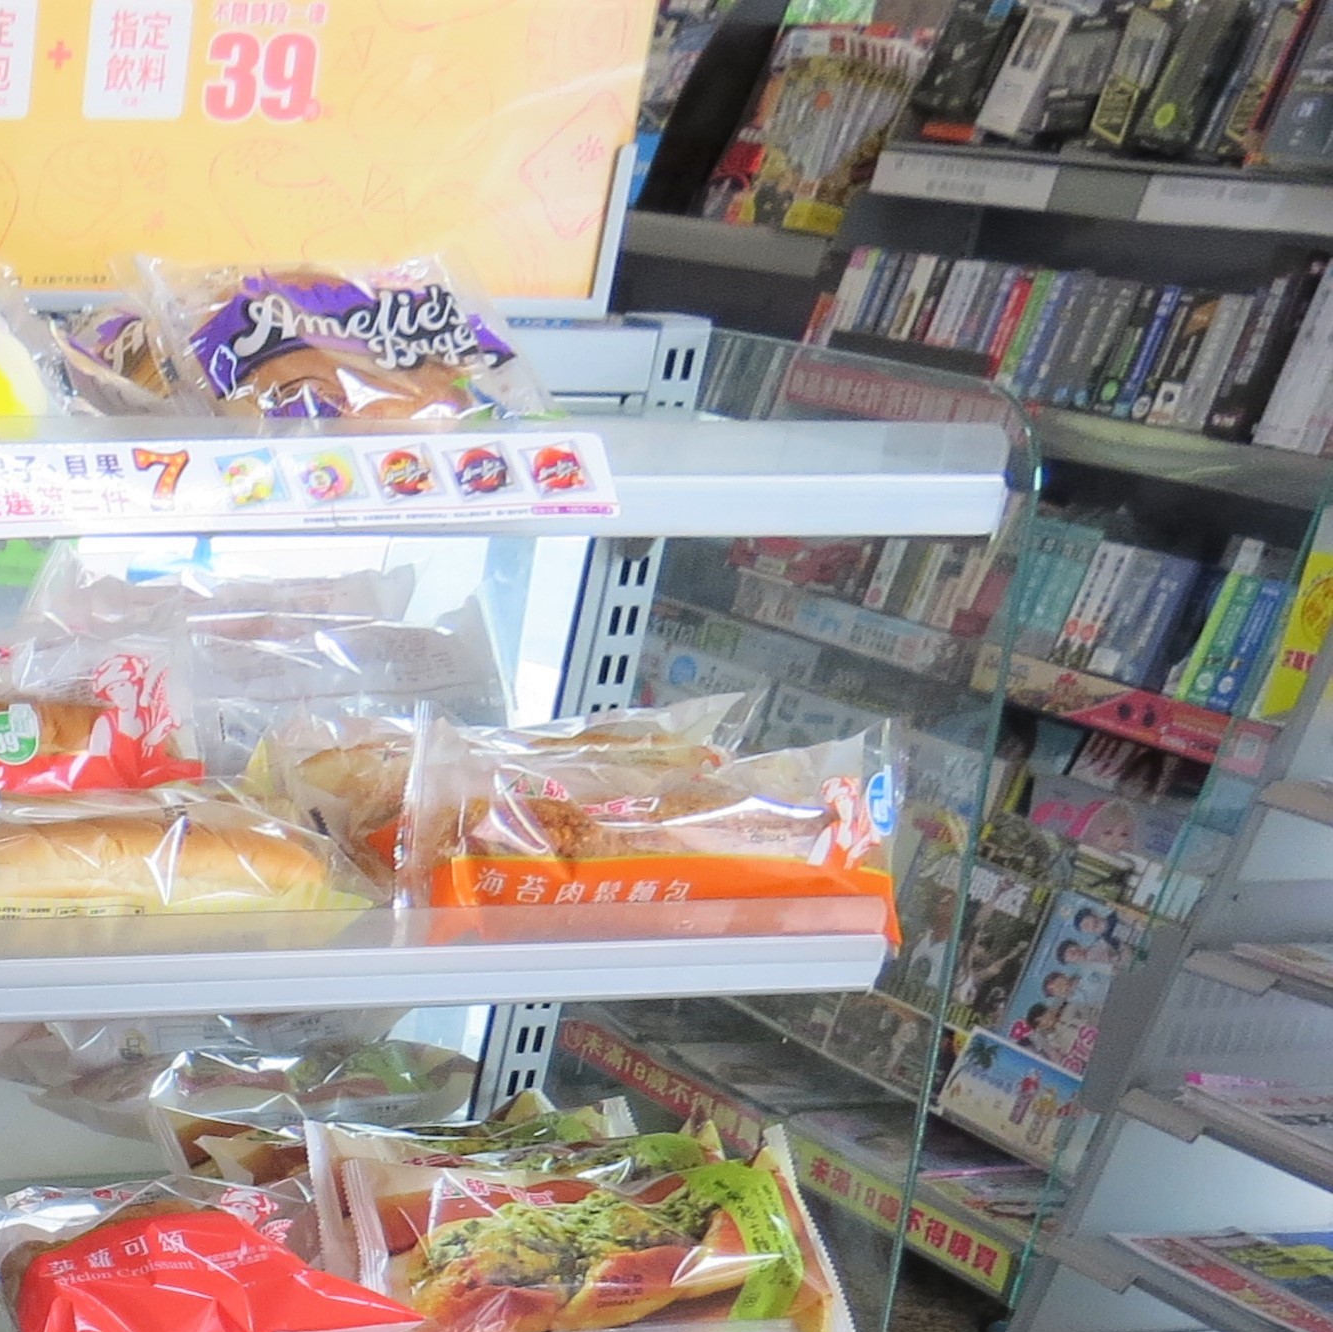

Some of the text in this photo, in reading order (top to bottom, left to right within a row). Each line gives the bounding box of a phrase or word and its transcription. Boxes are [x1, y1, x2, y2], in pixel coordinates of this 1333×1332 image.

[109, 10, 173, 51] 指定
[103, 54, 167, 93] 飲料
[205, 31, 317, 122] 39
[474, 866, 692, 904] 海苔肉鬆麵包
